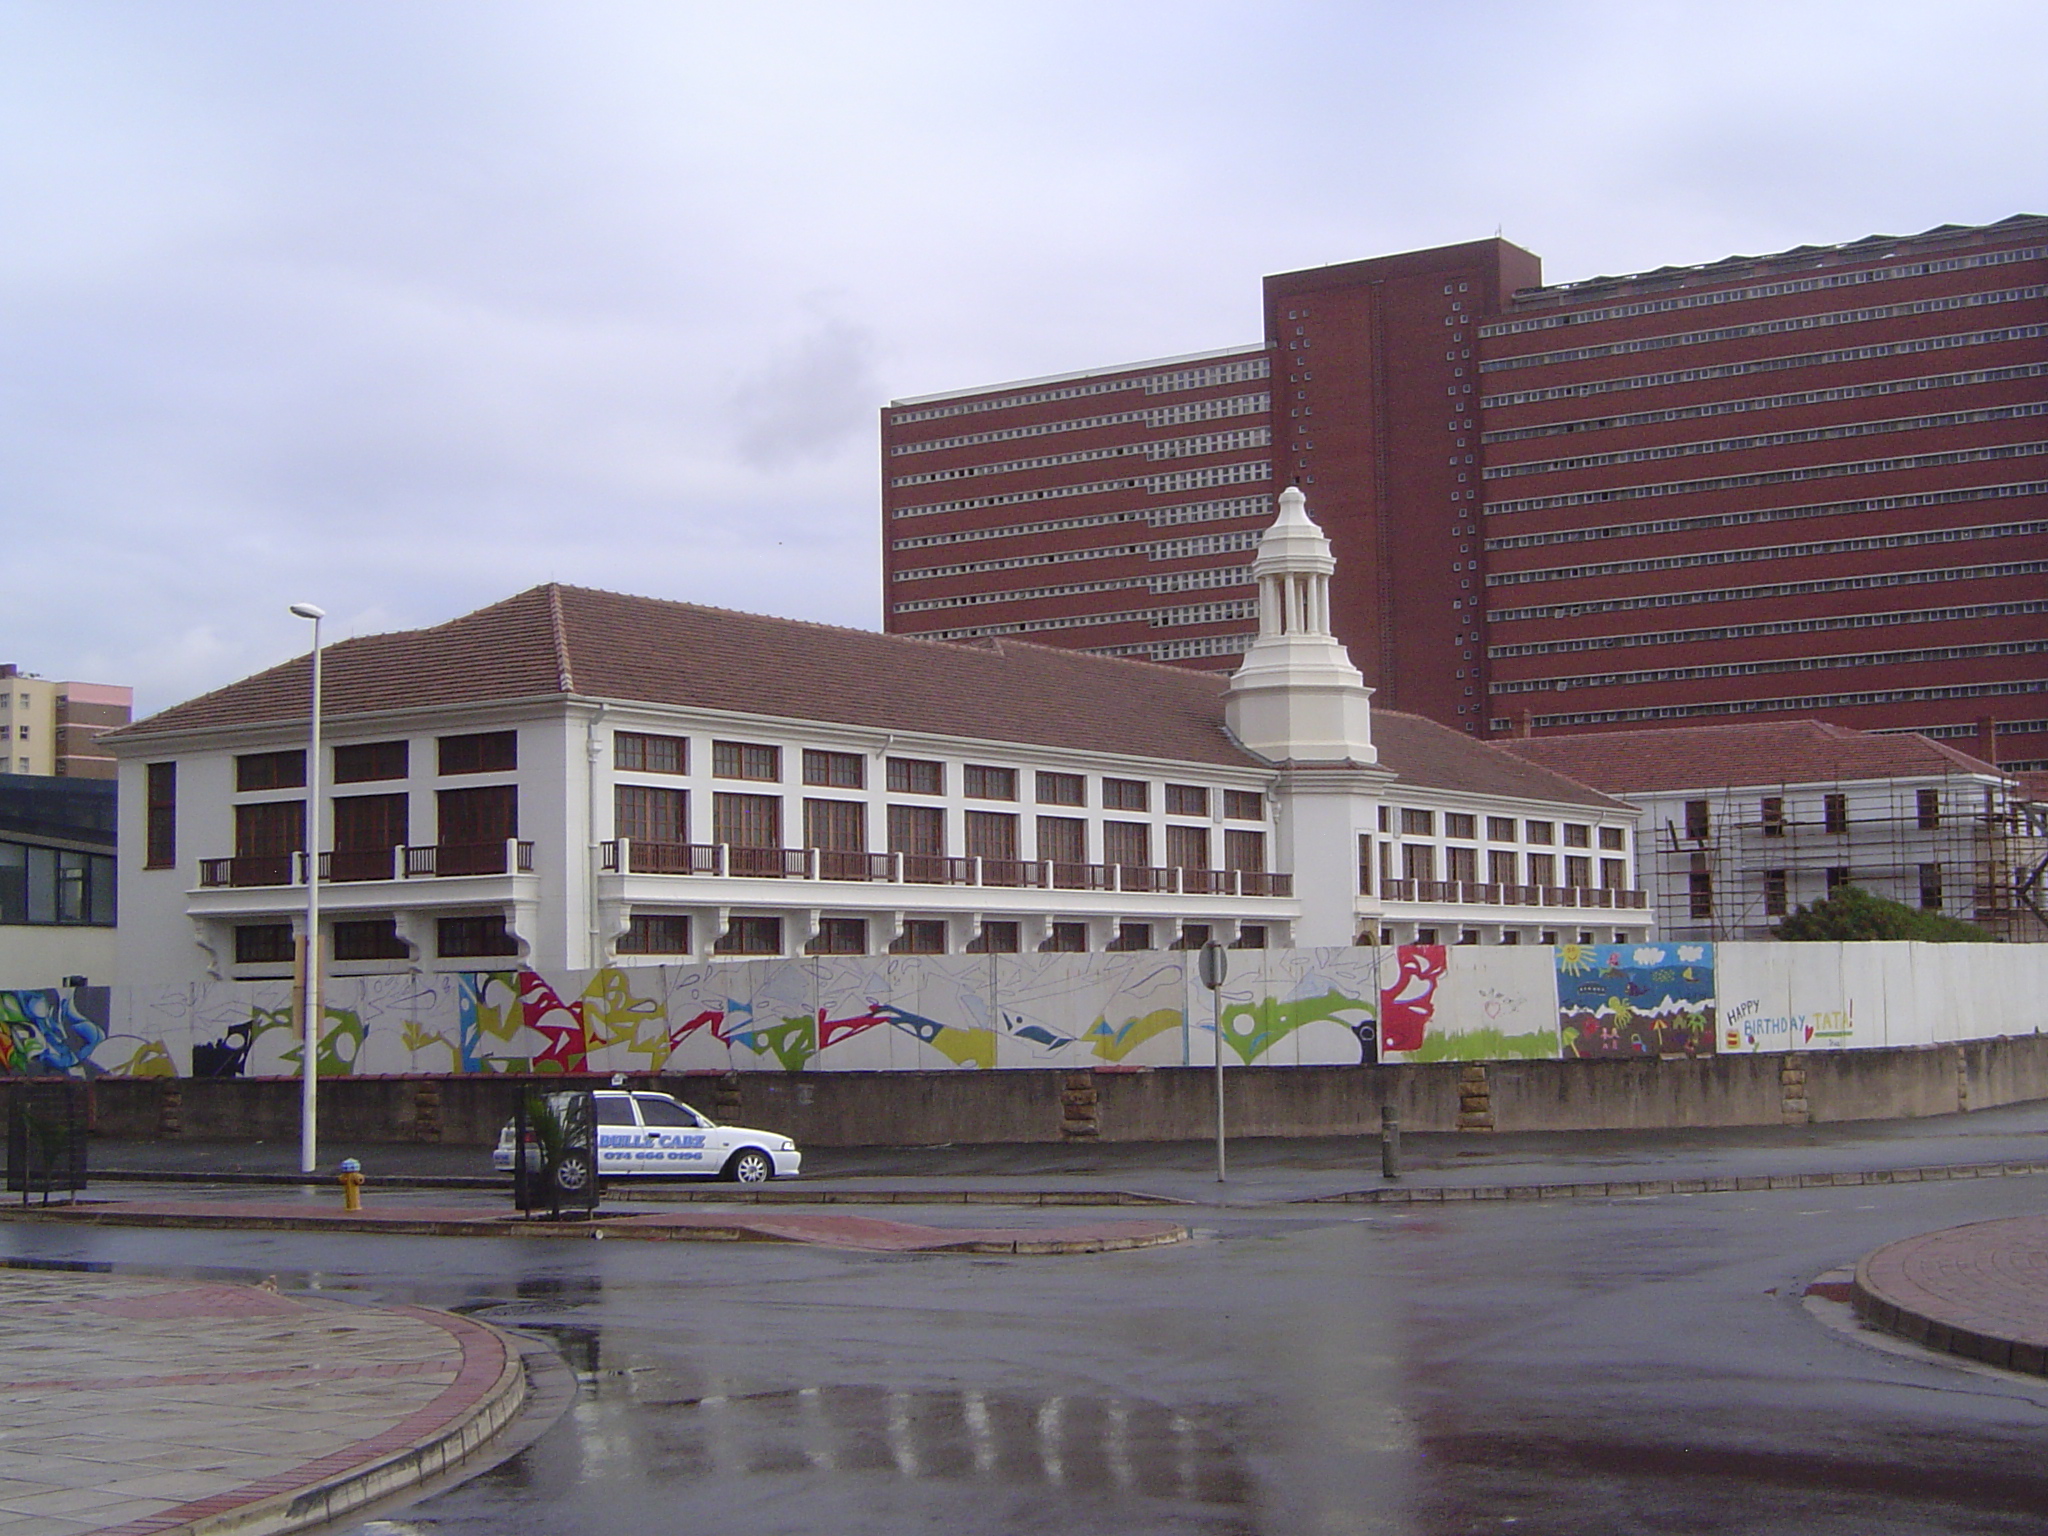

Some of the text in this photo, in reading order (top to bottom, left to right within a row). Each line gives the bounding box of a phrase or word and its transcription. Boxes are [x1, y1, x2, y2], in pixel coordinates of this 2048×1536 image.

[1727, 1000, 1760, 1026] HAPPY
[1744, 1015, 1805, 1036] BIRTHDAY
[659, 1135, 706, 1148] CABZ
[604, 1152, 632, 1160] 074
